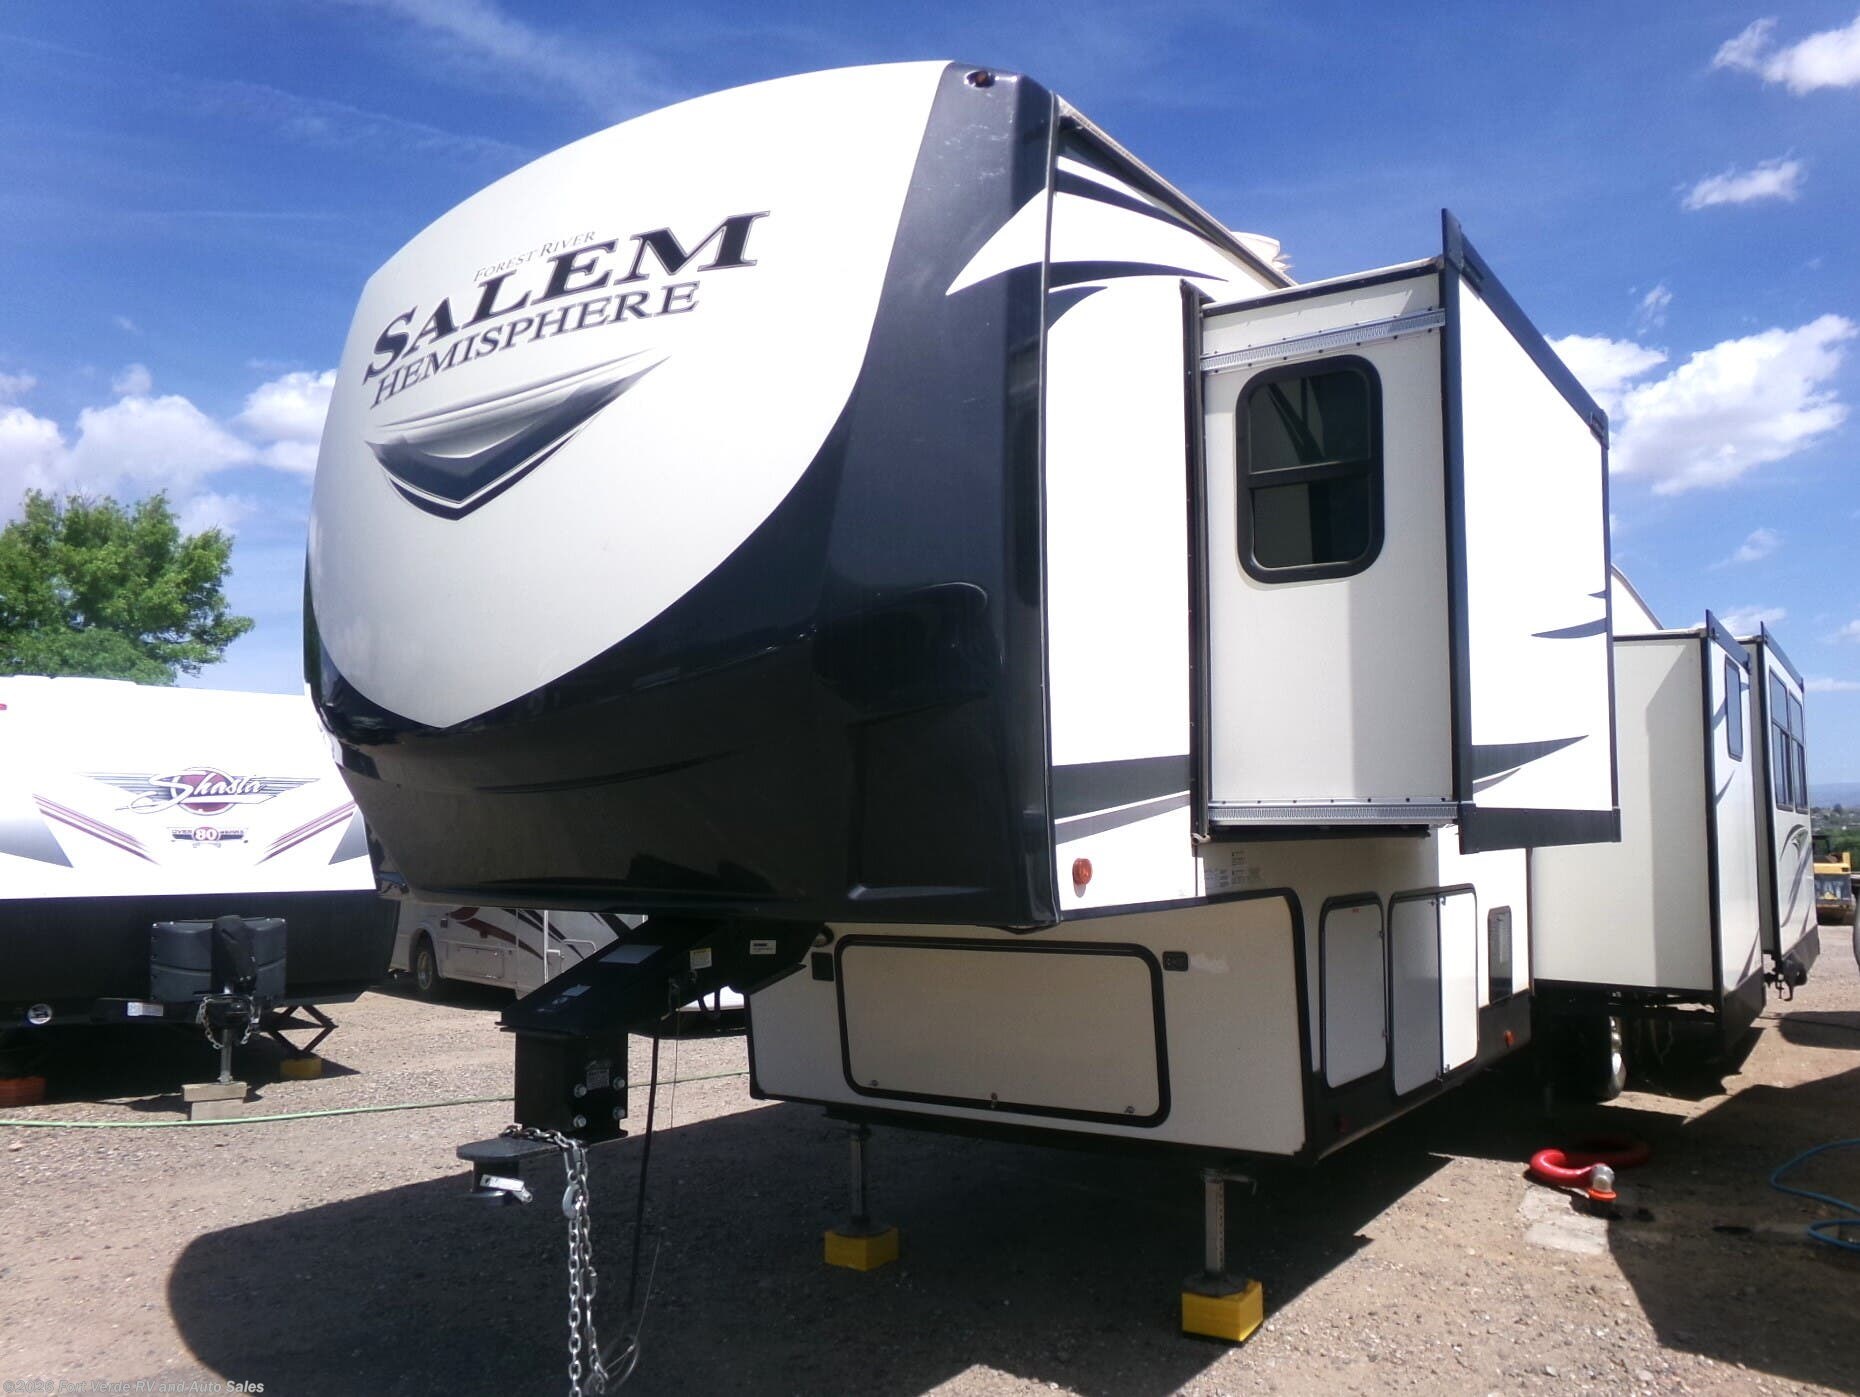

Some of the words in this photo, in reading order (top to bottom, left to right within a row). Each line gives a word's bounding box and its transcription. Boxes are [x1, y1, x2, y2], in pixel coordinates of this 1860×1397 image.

[473, 250, 536, 282] FOREST
[540, 231, 596, 257] RIVER
[362, 210, 771, 386] SALEM
[370, 280, 701, 410] HEMISPHERE
[116, 768, 268, 815] Shasta
[195, 828, 218, 841] 80
